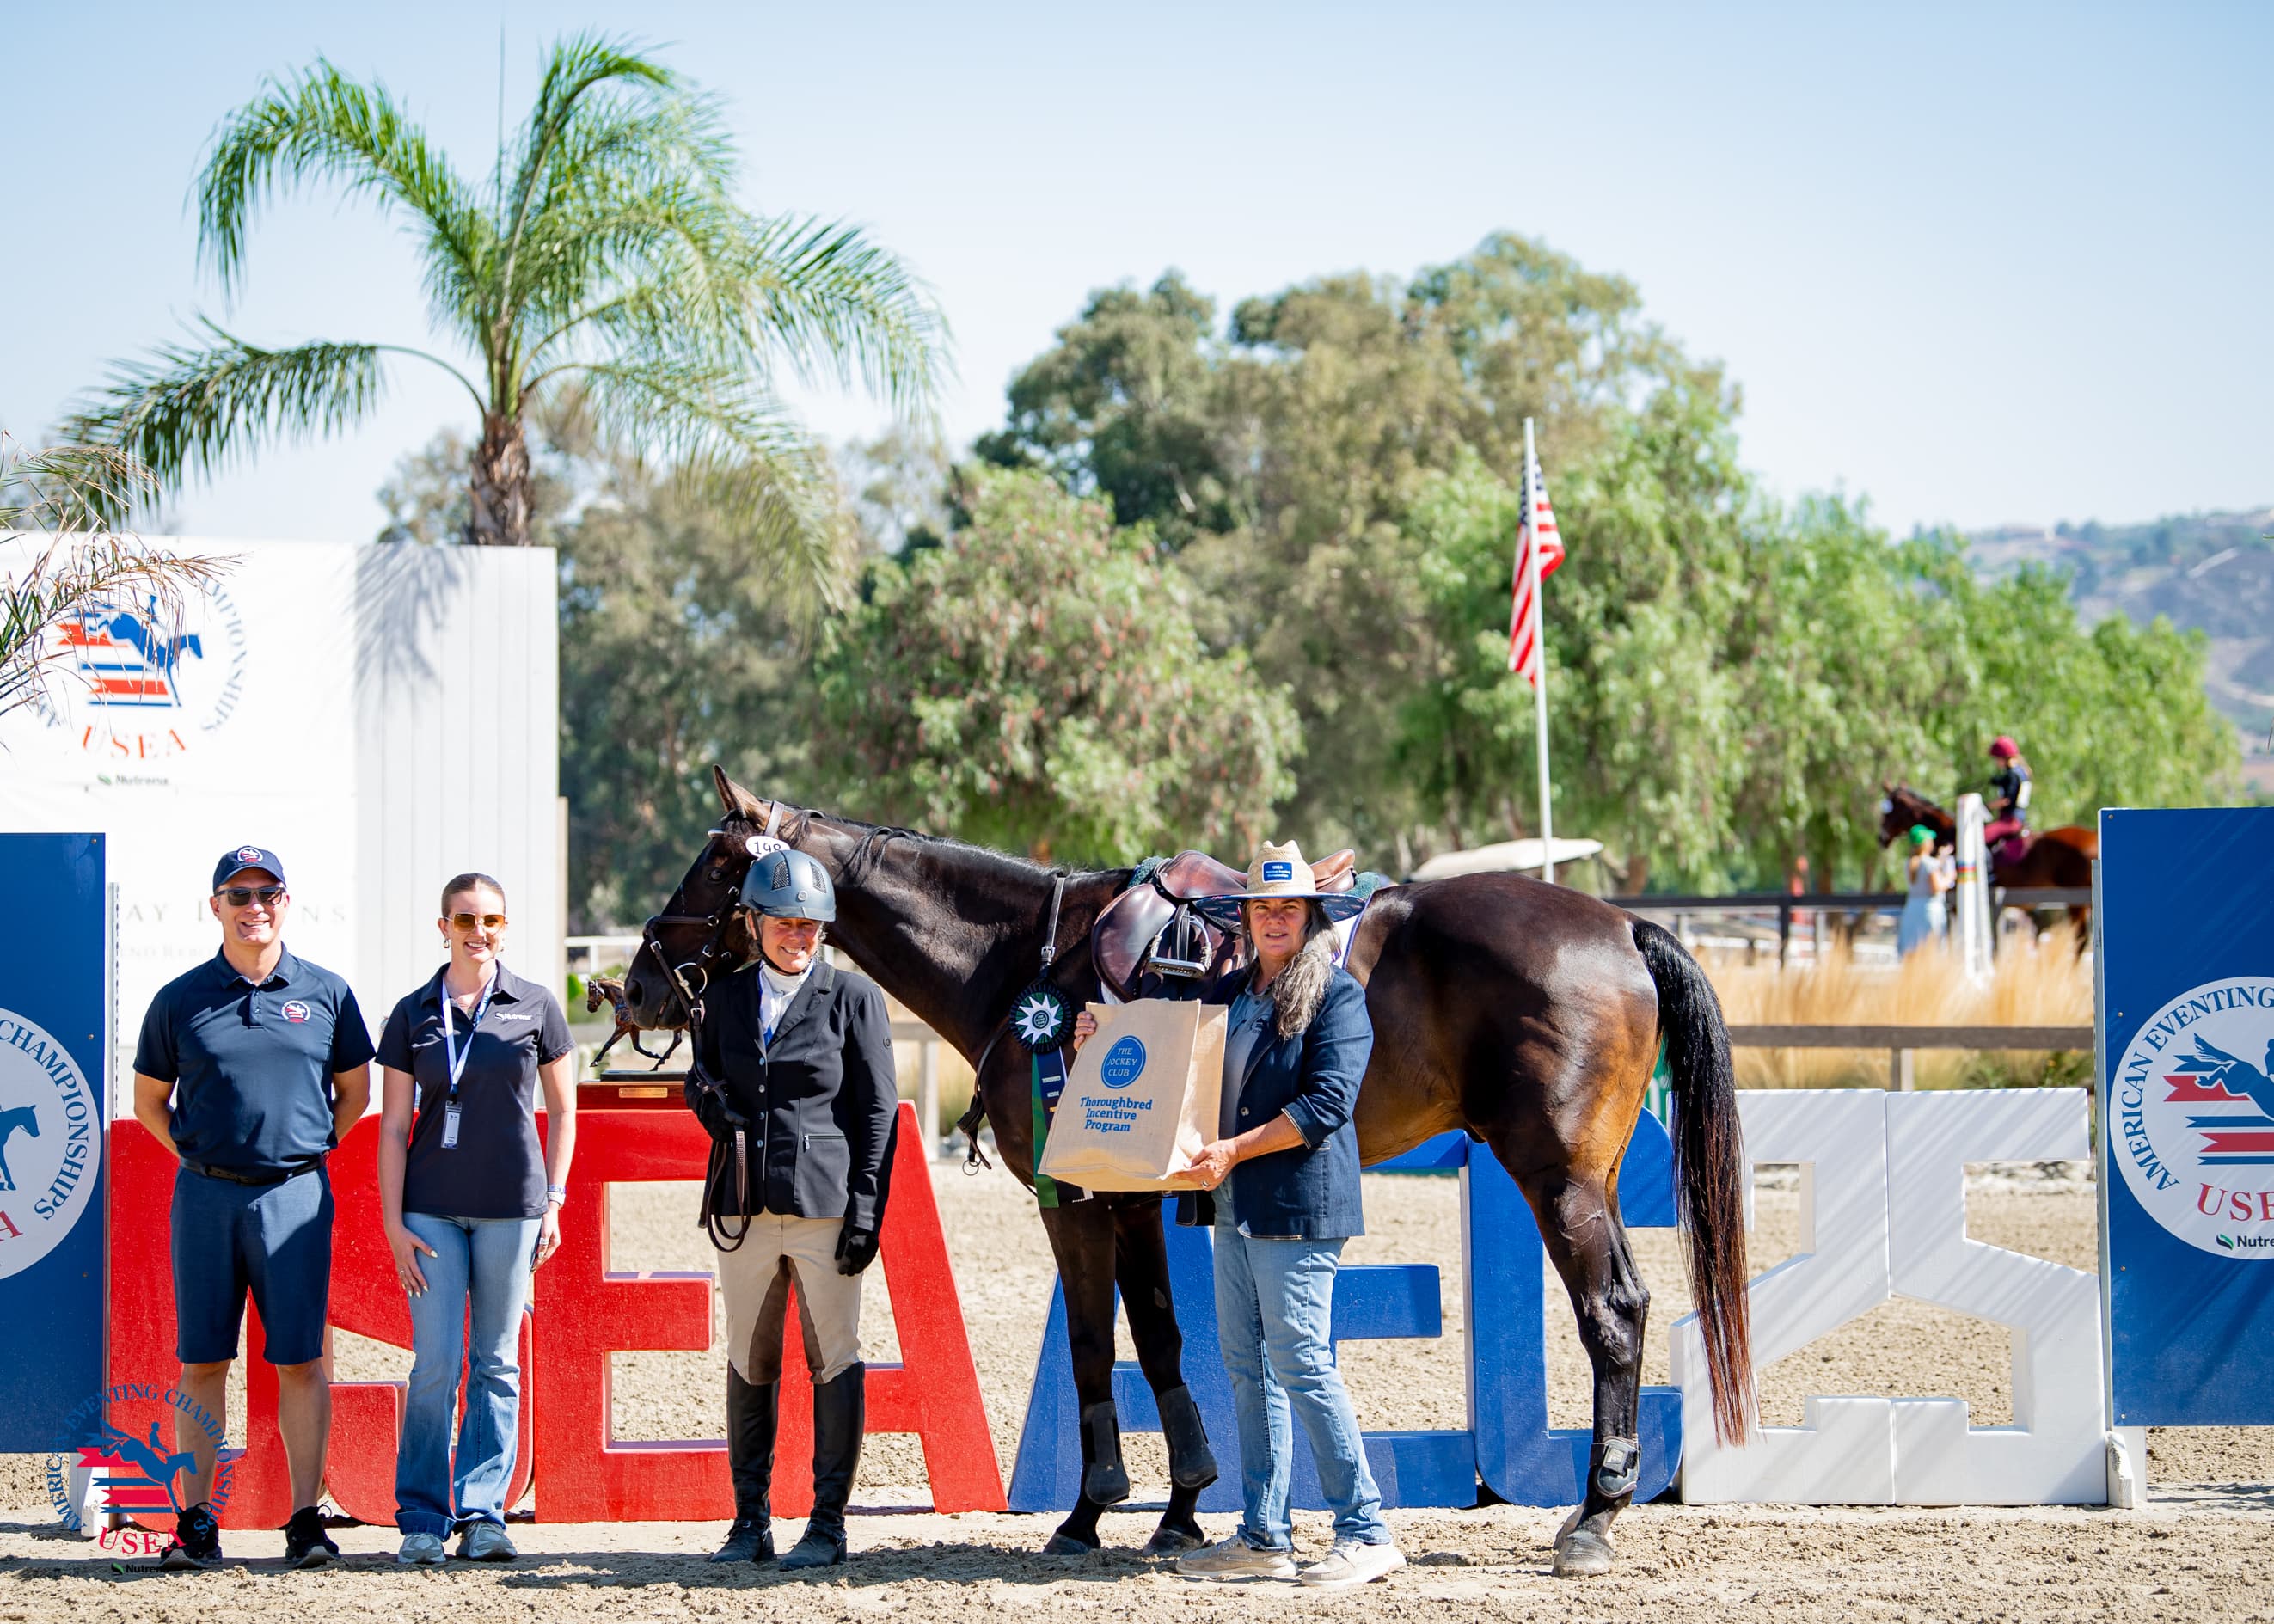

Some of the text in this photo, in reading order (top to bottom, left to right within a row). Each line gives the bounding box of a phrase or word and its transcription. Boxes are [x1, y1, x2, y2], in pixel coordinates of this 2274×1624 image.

[82, 725, 187, 760] USEA
[1117, 1047, 1134, 1056] THE
[2121, 986, 2274, 1192] AMERICAN EVENTING
[1080, 1096, 1153, 1110] Thoroughbred
[0, 1020, 89, 1220] CHAMPIONSHIPS
[1086, 1108, 1137, 1121] Incentive
[1084, 1119, 1131, 1133] Program
